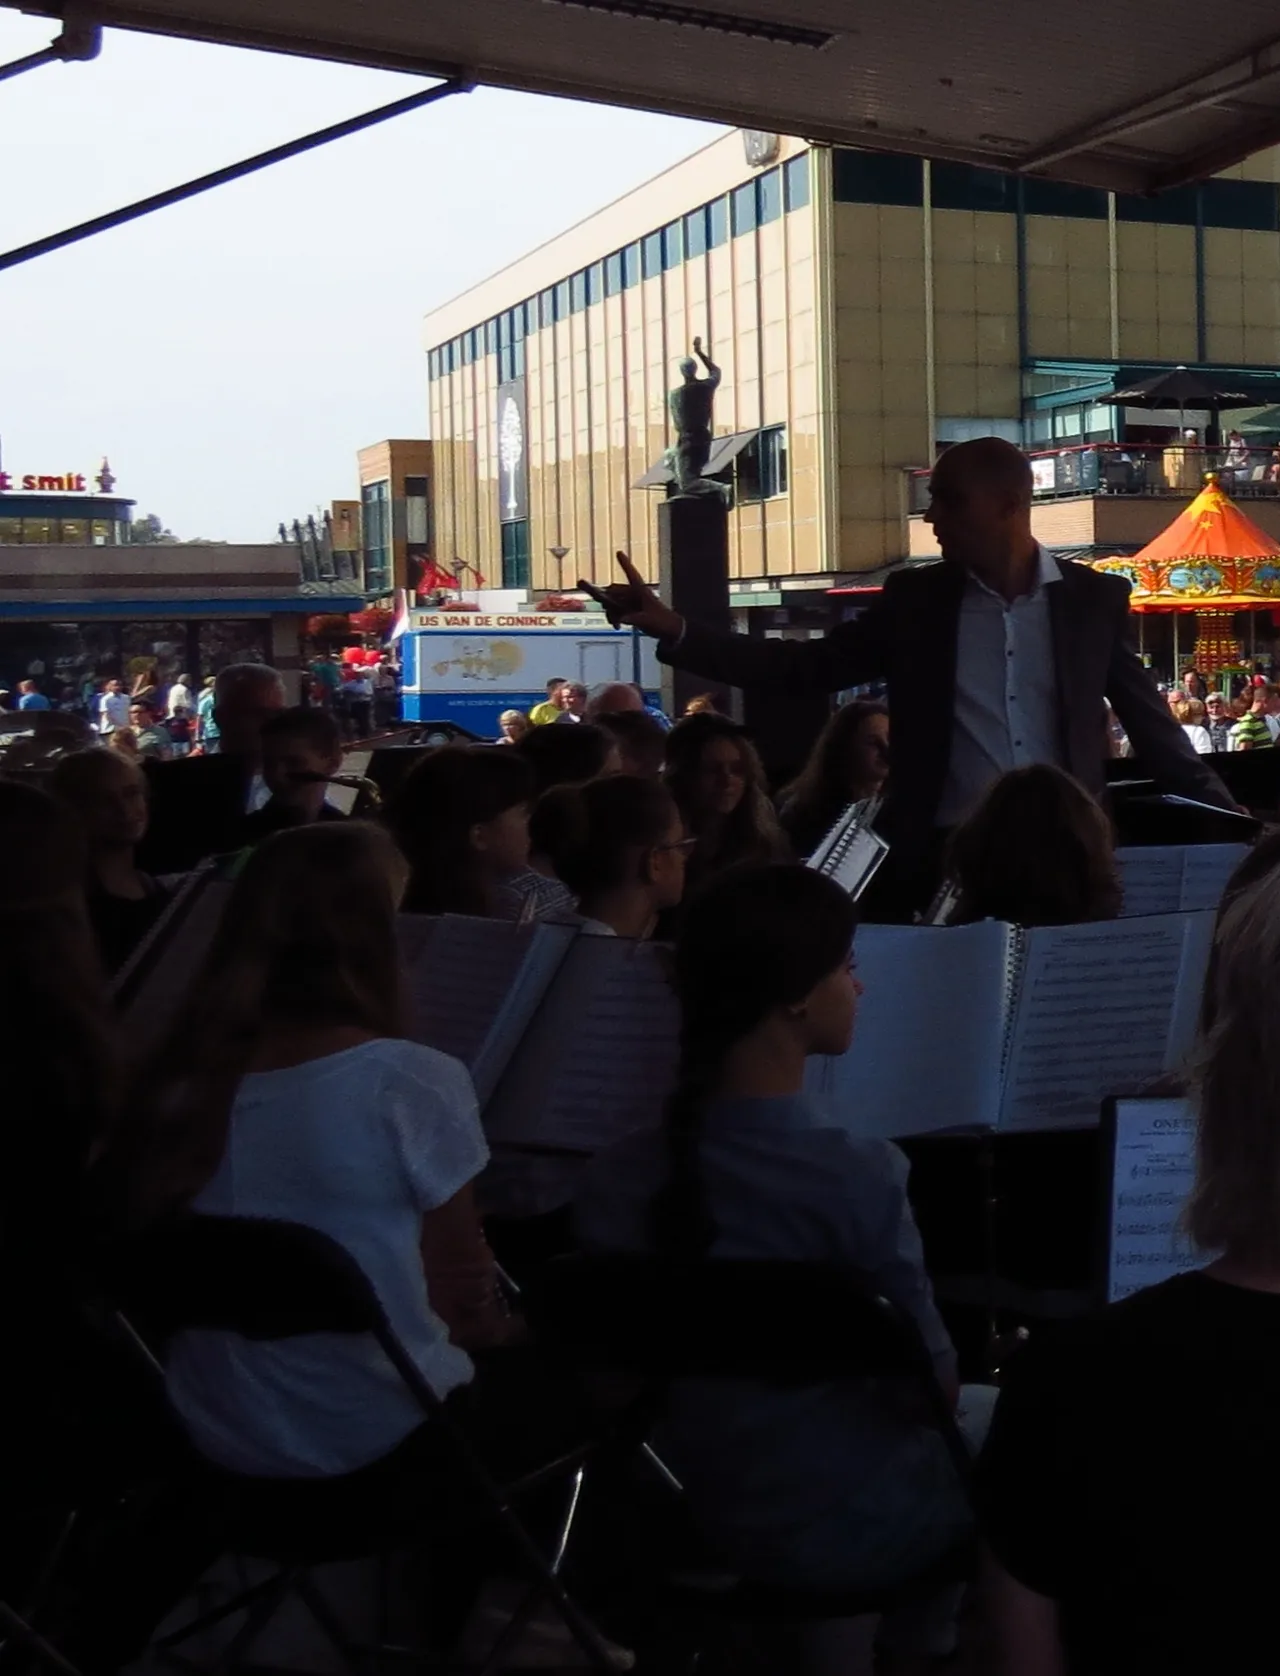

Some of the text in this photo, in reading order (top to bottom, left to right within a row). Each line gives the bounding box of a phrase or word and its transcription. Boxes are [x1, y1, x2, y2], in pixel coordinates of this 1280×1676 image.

[22, 472, 86, 492] smit
[444, 616, 470, 627] VAN
[474, 616, 492, 627] DE
[496, 616, 557, 627] CONINCK
